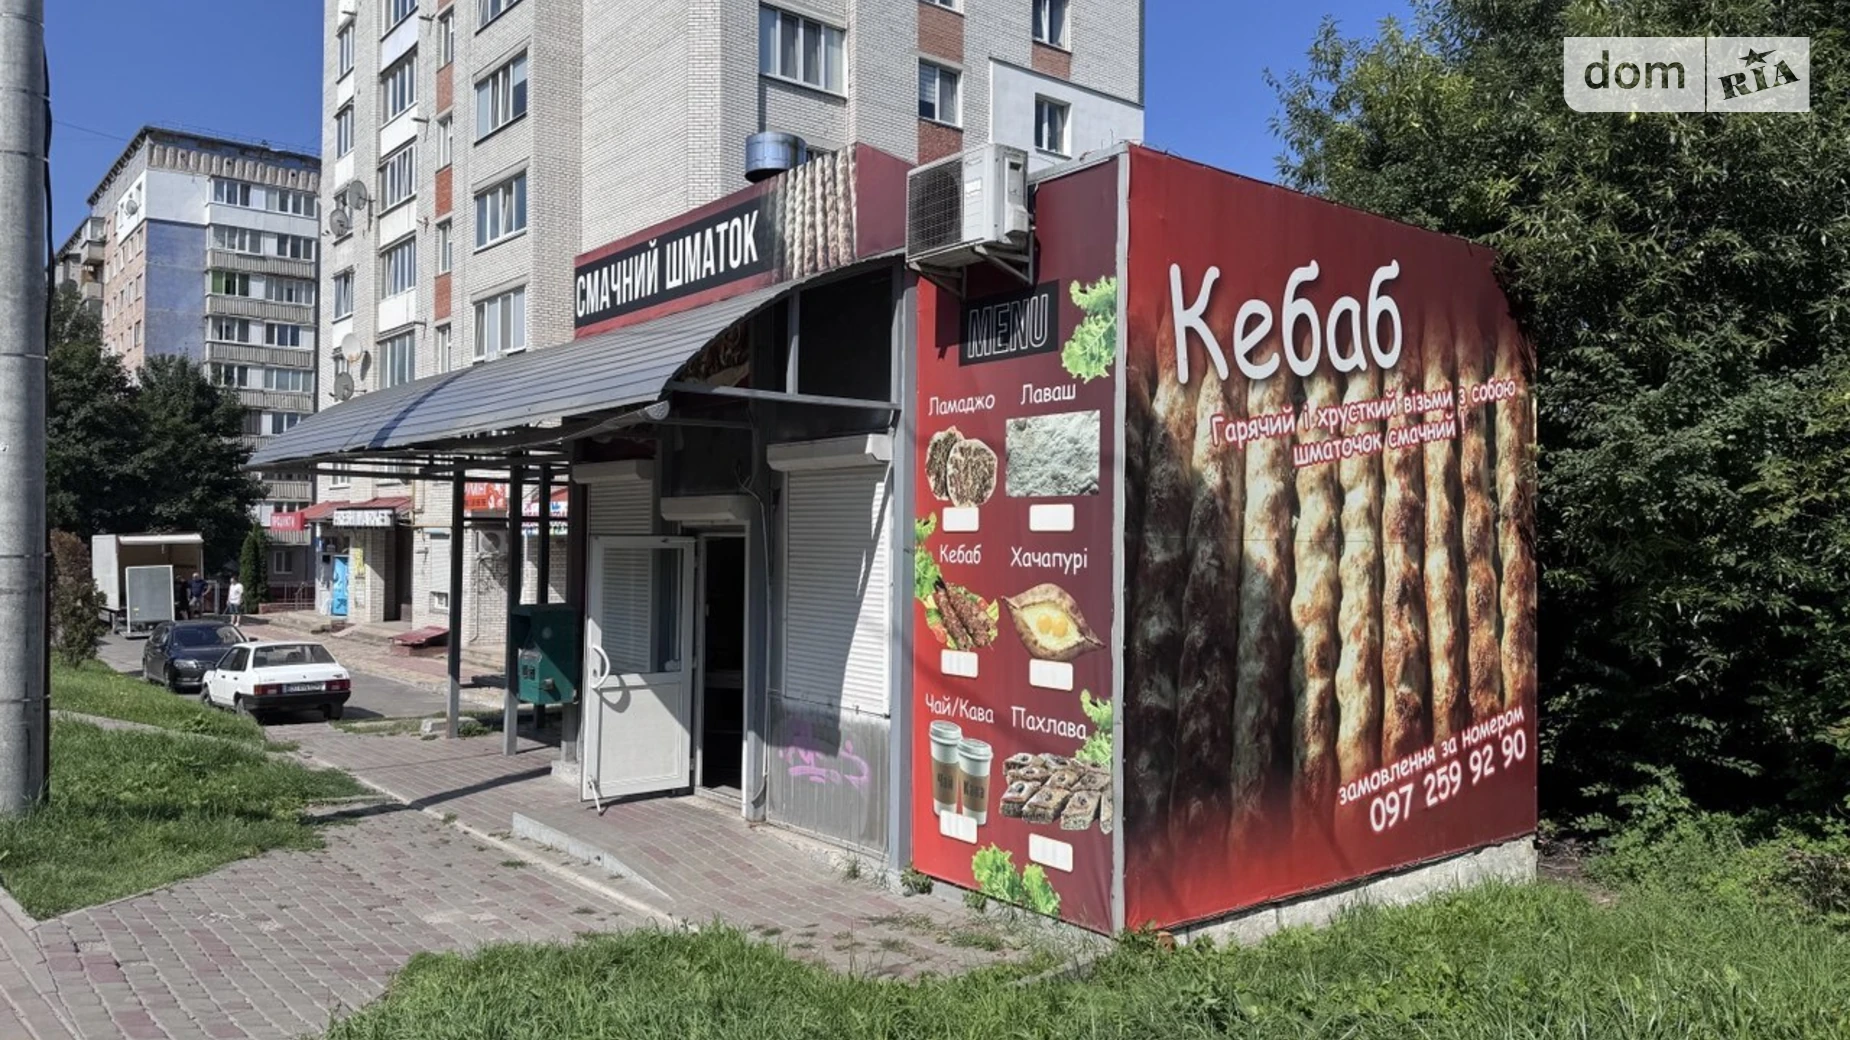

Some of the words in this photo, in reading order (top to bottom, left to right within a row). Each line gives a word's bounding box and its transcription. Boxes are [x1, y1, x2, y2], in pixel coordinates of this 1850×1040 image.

[576, 239, 659, 318] СМАЧНИЙ
[665, 210, 759, 291] ШМАТОК
[967, 293, 1049, 359] MENU
[1169, 259, 1402, 385] Кебаб
[928, 394, 996, 416] Ламаджо
[1020, 383, 1076, 406] Лаваш
[1211, 406, 1296, 448] Гарячий
[1317, 389, 1398, 435] хрусткий
[1403, 388, 1454, 414] візьми
[1471, 378, 1516, 404] собою
[1292, 431, 1382, 467] шматочок
[1387, 415, 1457, 449] смачний
[939, 544, 982, 565] Кебаб
[1010, 547, 1088, 575] Хачапурі
[924, 693, 995, 725] Чай/Кава
[1010, 705, 1087, 740] Пахлава
[1338, 745, 1436, 806] замовлення
[1440, 740, 1457, 759] за
[1461, 705, 1525, 749] номером
[1369, 782, 1414, 833] 097
[1423, 759, 1462, 808] 259
[1468, 744, 1496, 785] 92
[1500, 728, 1527, 769] 90
